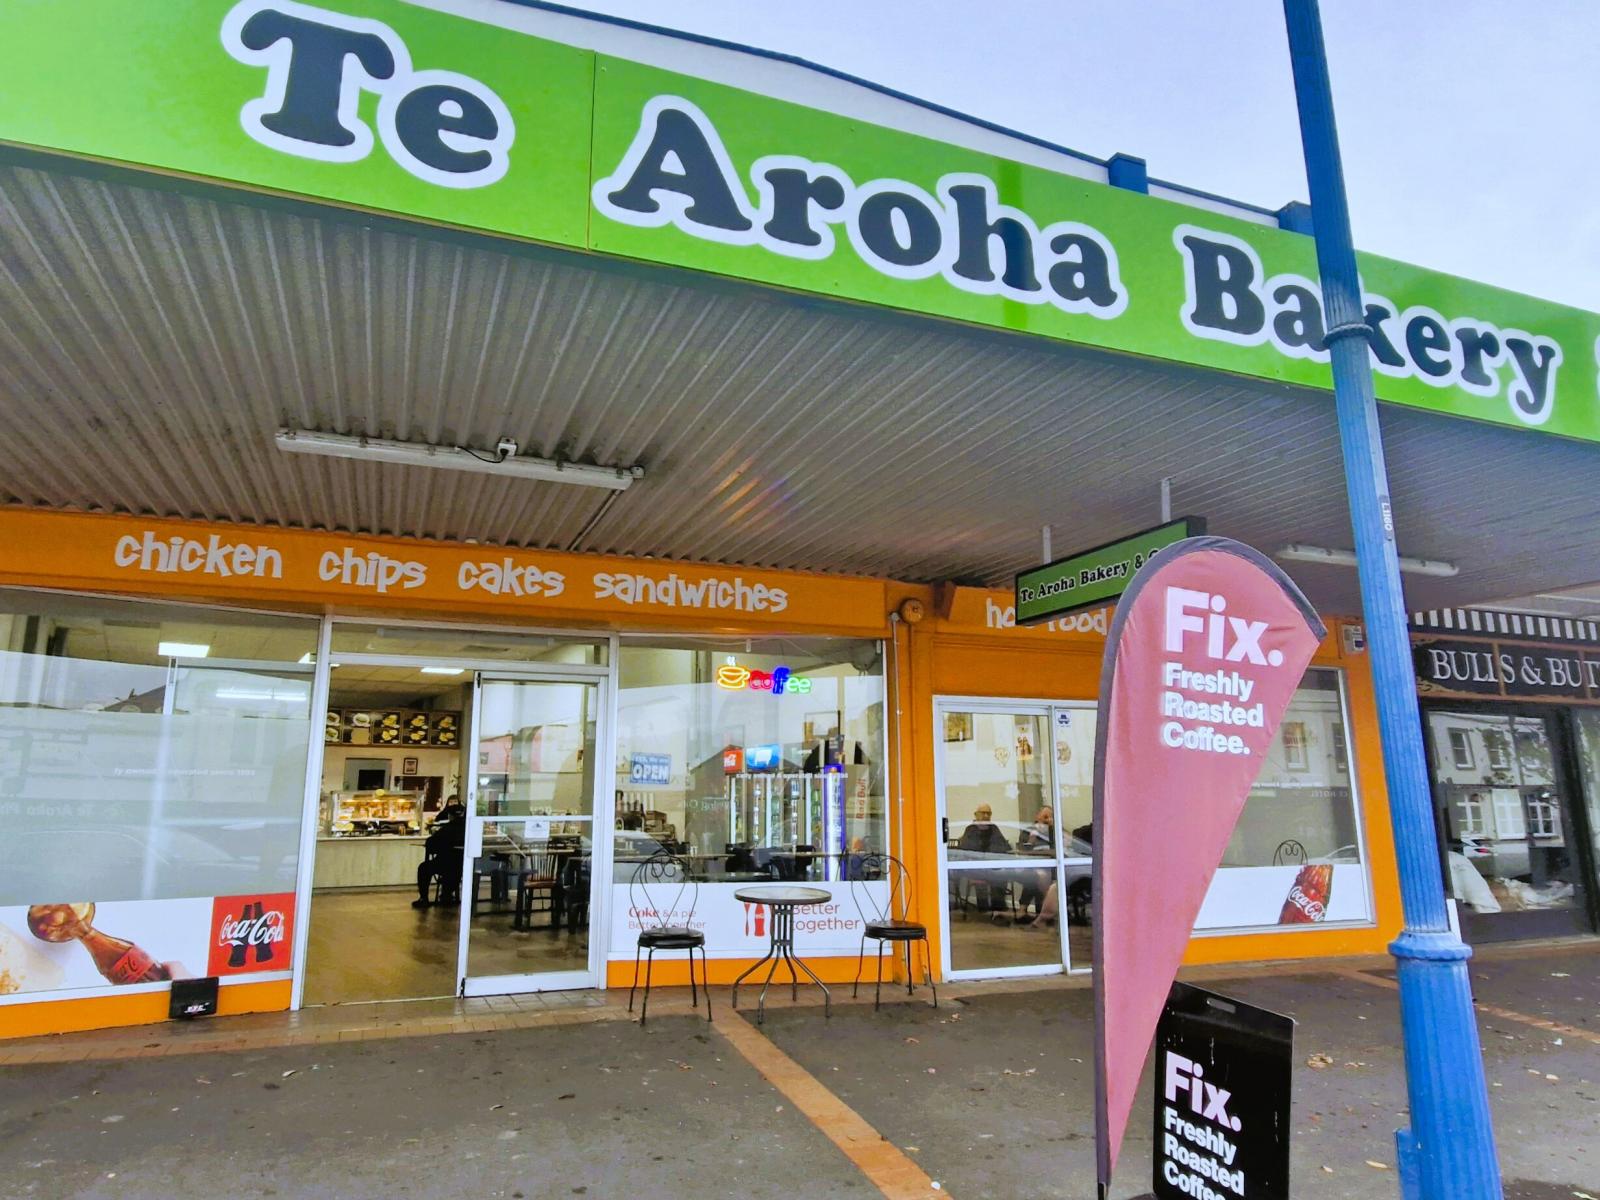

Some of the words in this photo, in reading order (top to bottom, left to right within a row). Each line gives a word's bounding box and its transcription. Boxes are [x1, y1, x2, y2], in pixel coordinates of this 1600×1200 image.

[236, 6, 503, 178] Te
[602, 106, 1120, 311] Aroha
[114, 531, 282, 578] chicken
[319, 547, 428, 593] chips
[458, 557, 565, 596] cakes
[593, 573, 788, 613] sandwiches
[1020, 588, 1034, 603] Te
[1038, 577, 1075, 598] Aroha
[1080, 561, 1130, 586] Bakery
[1134, 555, 1143, 569] &
[1166, 586, 1284, 667] Fix.
[750, 666, 812, 694] coffee
[1164, 661, 1254, 702] Freshly
[1521, 656, 1546, 685] &
[1162, 691, 1265, 727] Roasted
[1161, 721, 1251, 755] Coffee.
[633, 764, 669, 780] OPEN
[1165, 1051, 1242, 1132] Fix.
[1164, 1106, 1236, 1165] Freshly
[1164, 1132, 1245, 1197] Roasted
